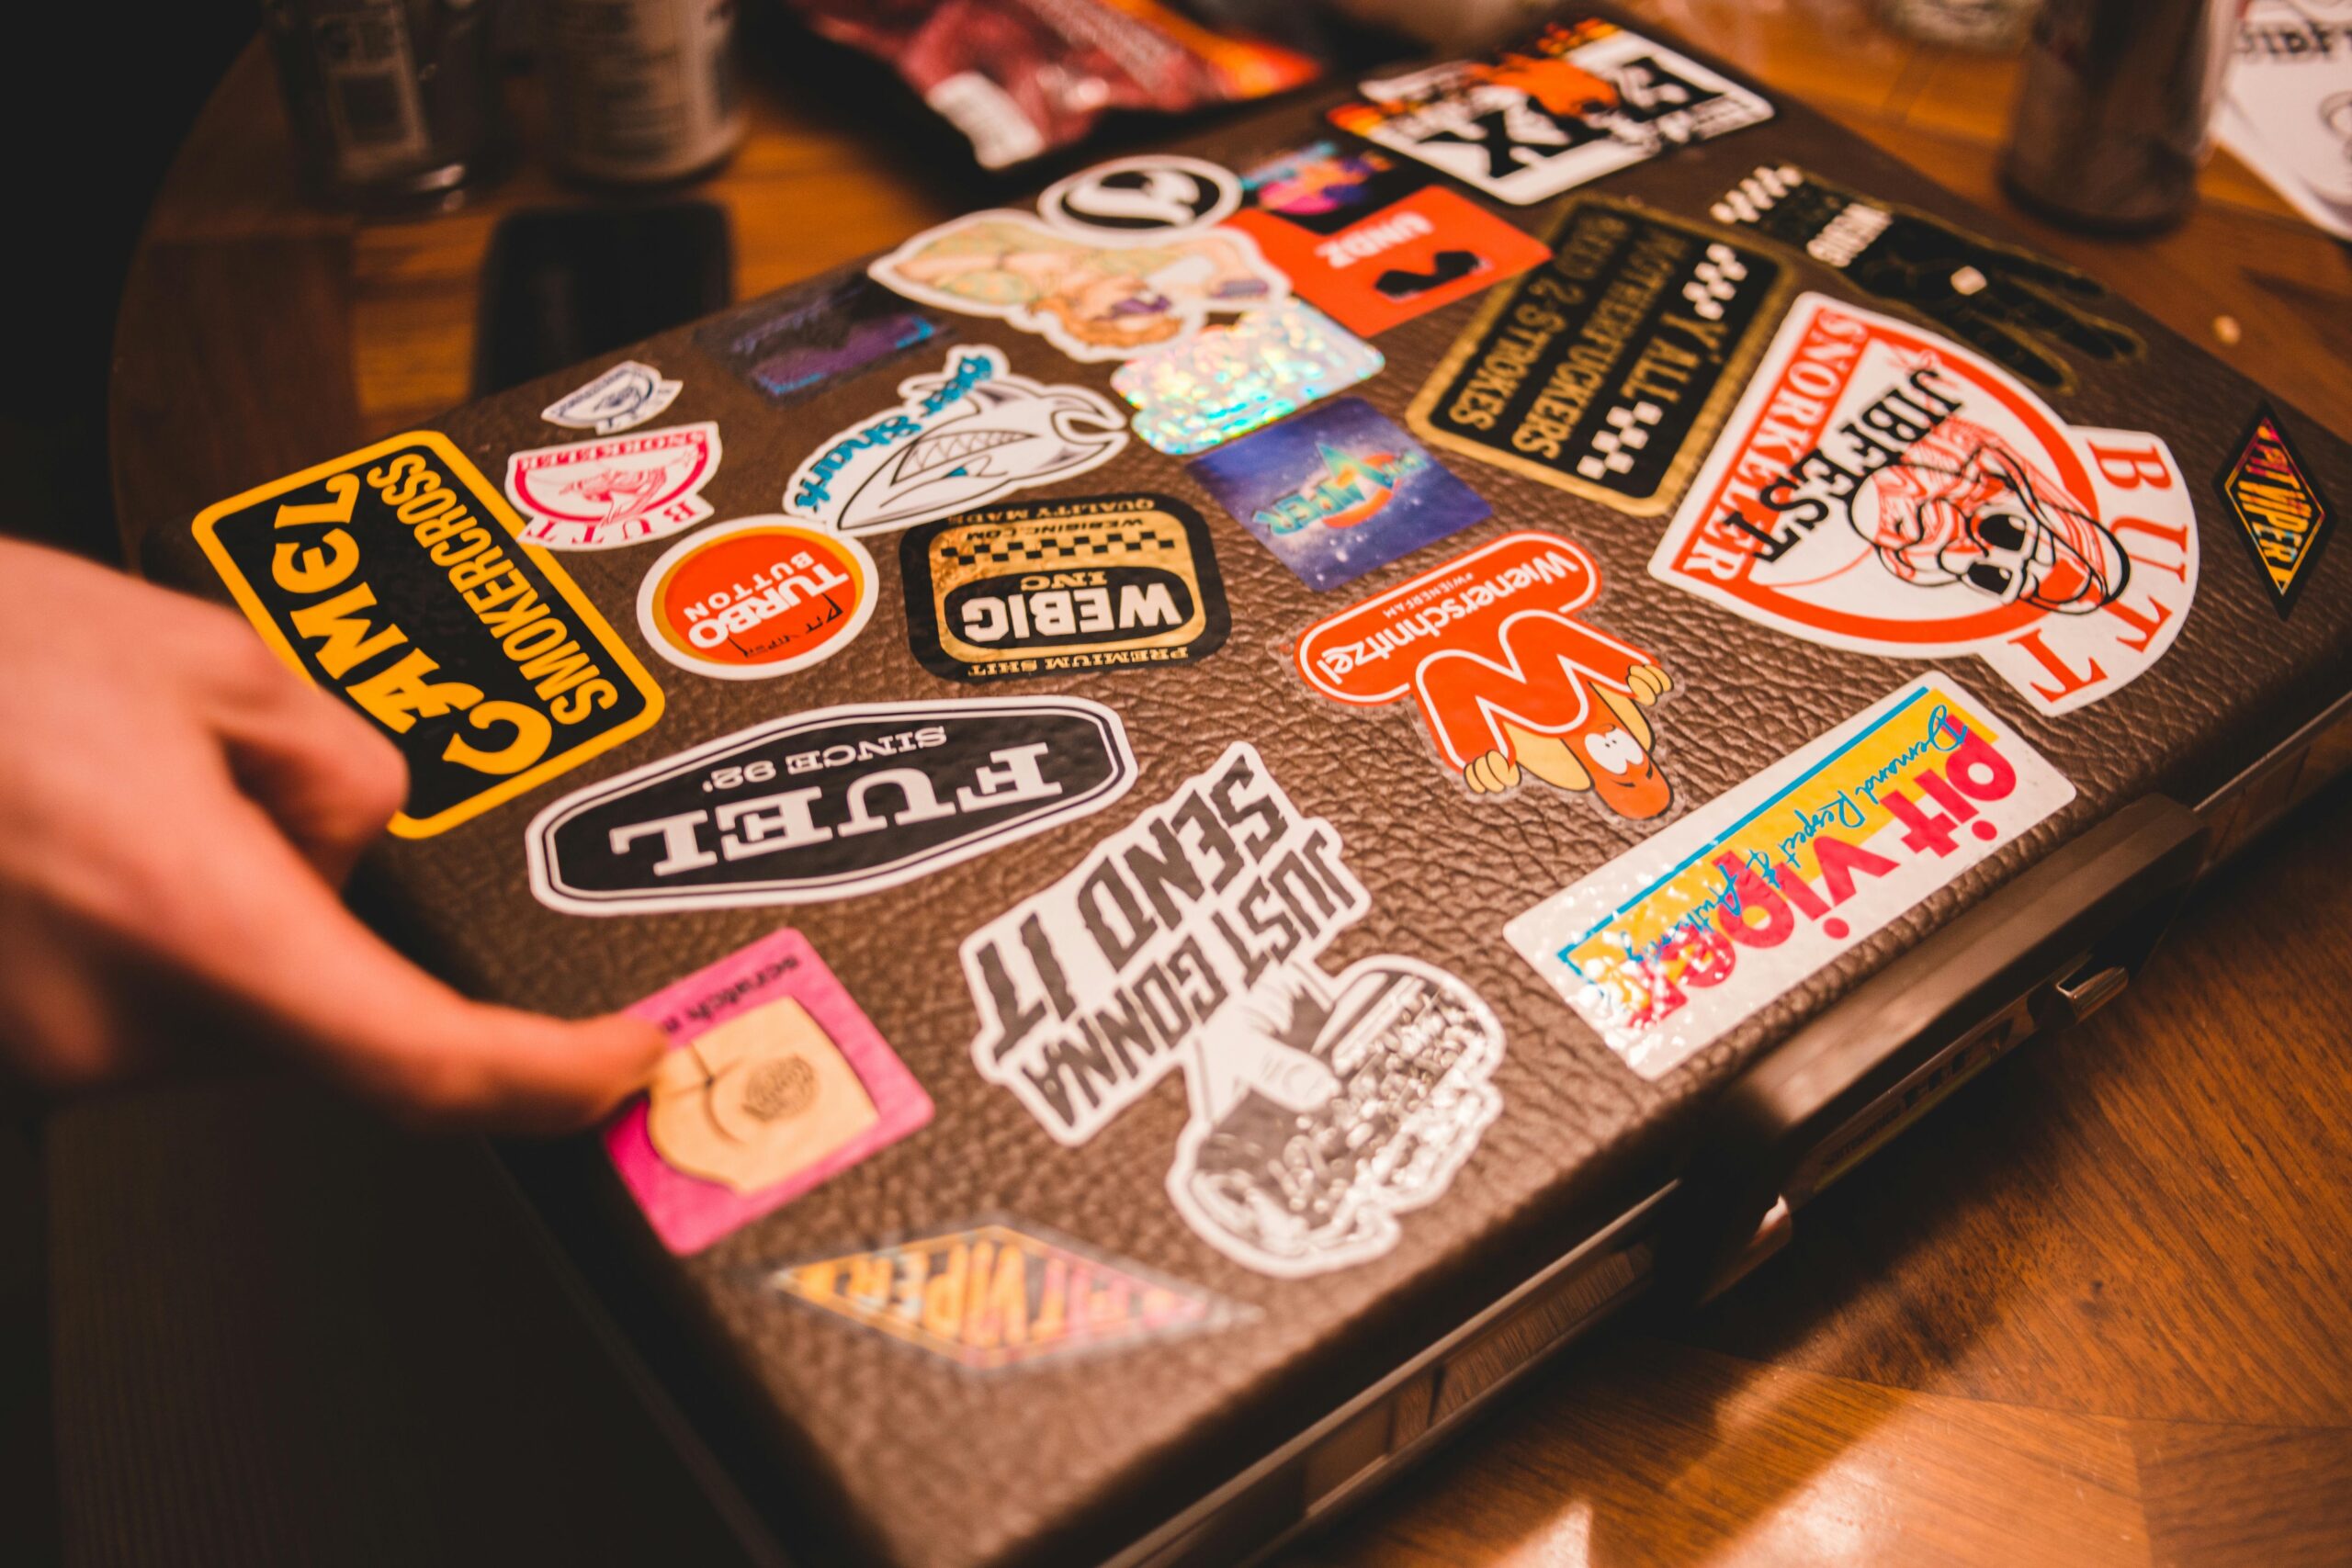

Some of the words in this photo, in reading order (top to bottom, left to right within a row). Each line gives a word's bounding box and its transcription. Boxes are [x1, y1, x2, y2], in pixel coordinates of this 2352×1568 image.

[793, 413, 922, 513] Shark
[1035, 497, 1156, 519] QUALITY
[1681, 307, 1871, 584] SNORKELER
[1719, 367, 1964, 563] JIBFEST
[367, 452, 618, 726] SMOKERCROSS
[526, 499, 698, 545] BUTT
[683, 550, 816, 623] BUTTON
[1020, 570, 1108, 592] INC
[2007, 438, 2189, 704] BUTT
[687, 562, 850, 649] TURBO
[960, 582, 1183, 643] WEBIG
[1044, 646, 1189, 671] PREMIUM
[1316, 549, 1579, 686] Wienerschnitzel
[608, 741, 1063, 876] FUEL
[785, 725, 947, 775] SINCE
[1855, 704, 1969, 806] Demand
[1879, 712, 2018, 860] pit
[1076, 753, 1290, 974] SEND
[1777, 789, 1866, 869] Respect
[1210, 829, 1358, 988] JUST
[1624, 834, 1902, 1028] viper
[976, 910, 1078, 1063] IT
[1021, 933, 1228, 1128] GONNA
